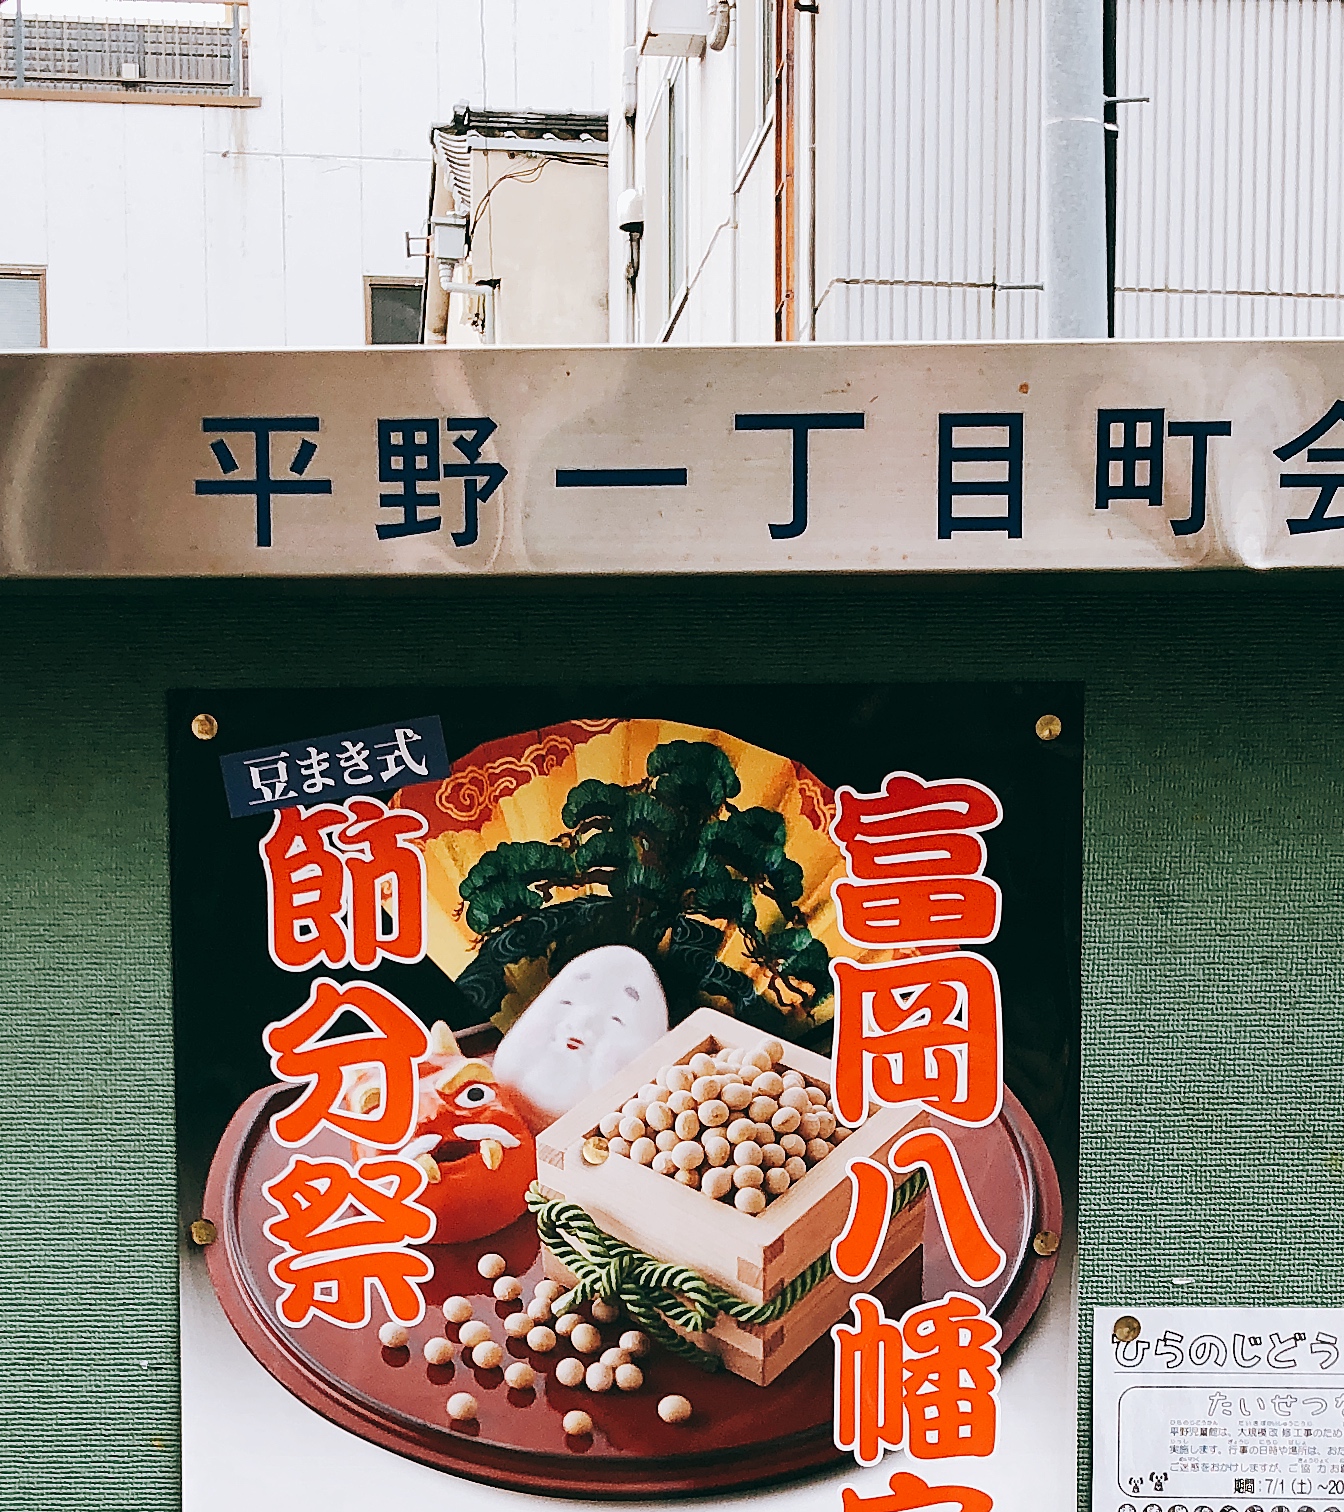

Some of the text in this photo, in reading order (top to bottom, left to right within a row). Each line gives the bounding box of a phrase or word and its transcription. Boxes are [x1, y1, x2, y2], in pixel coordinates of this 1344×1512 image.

[243, 726, 430, 807] 豆まき式
[260, 797, 437, 1329] 節分祭
